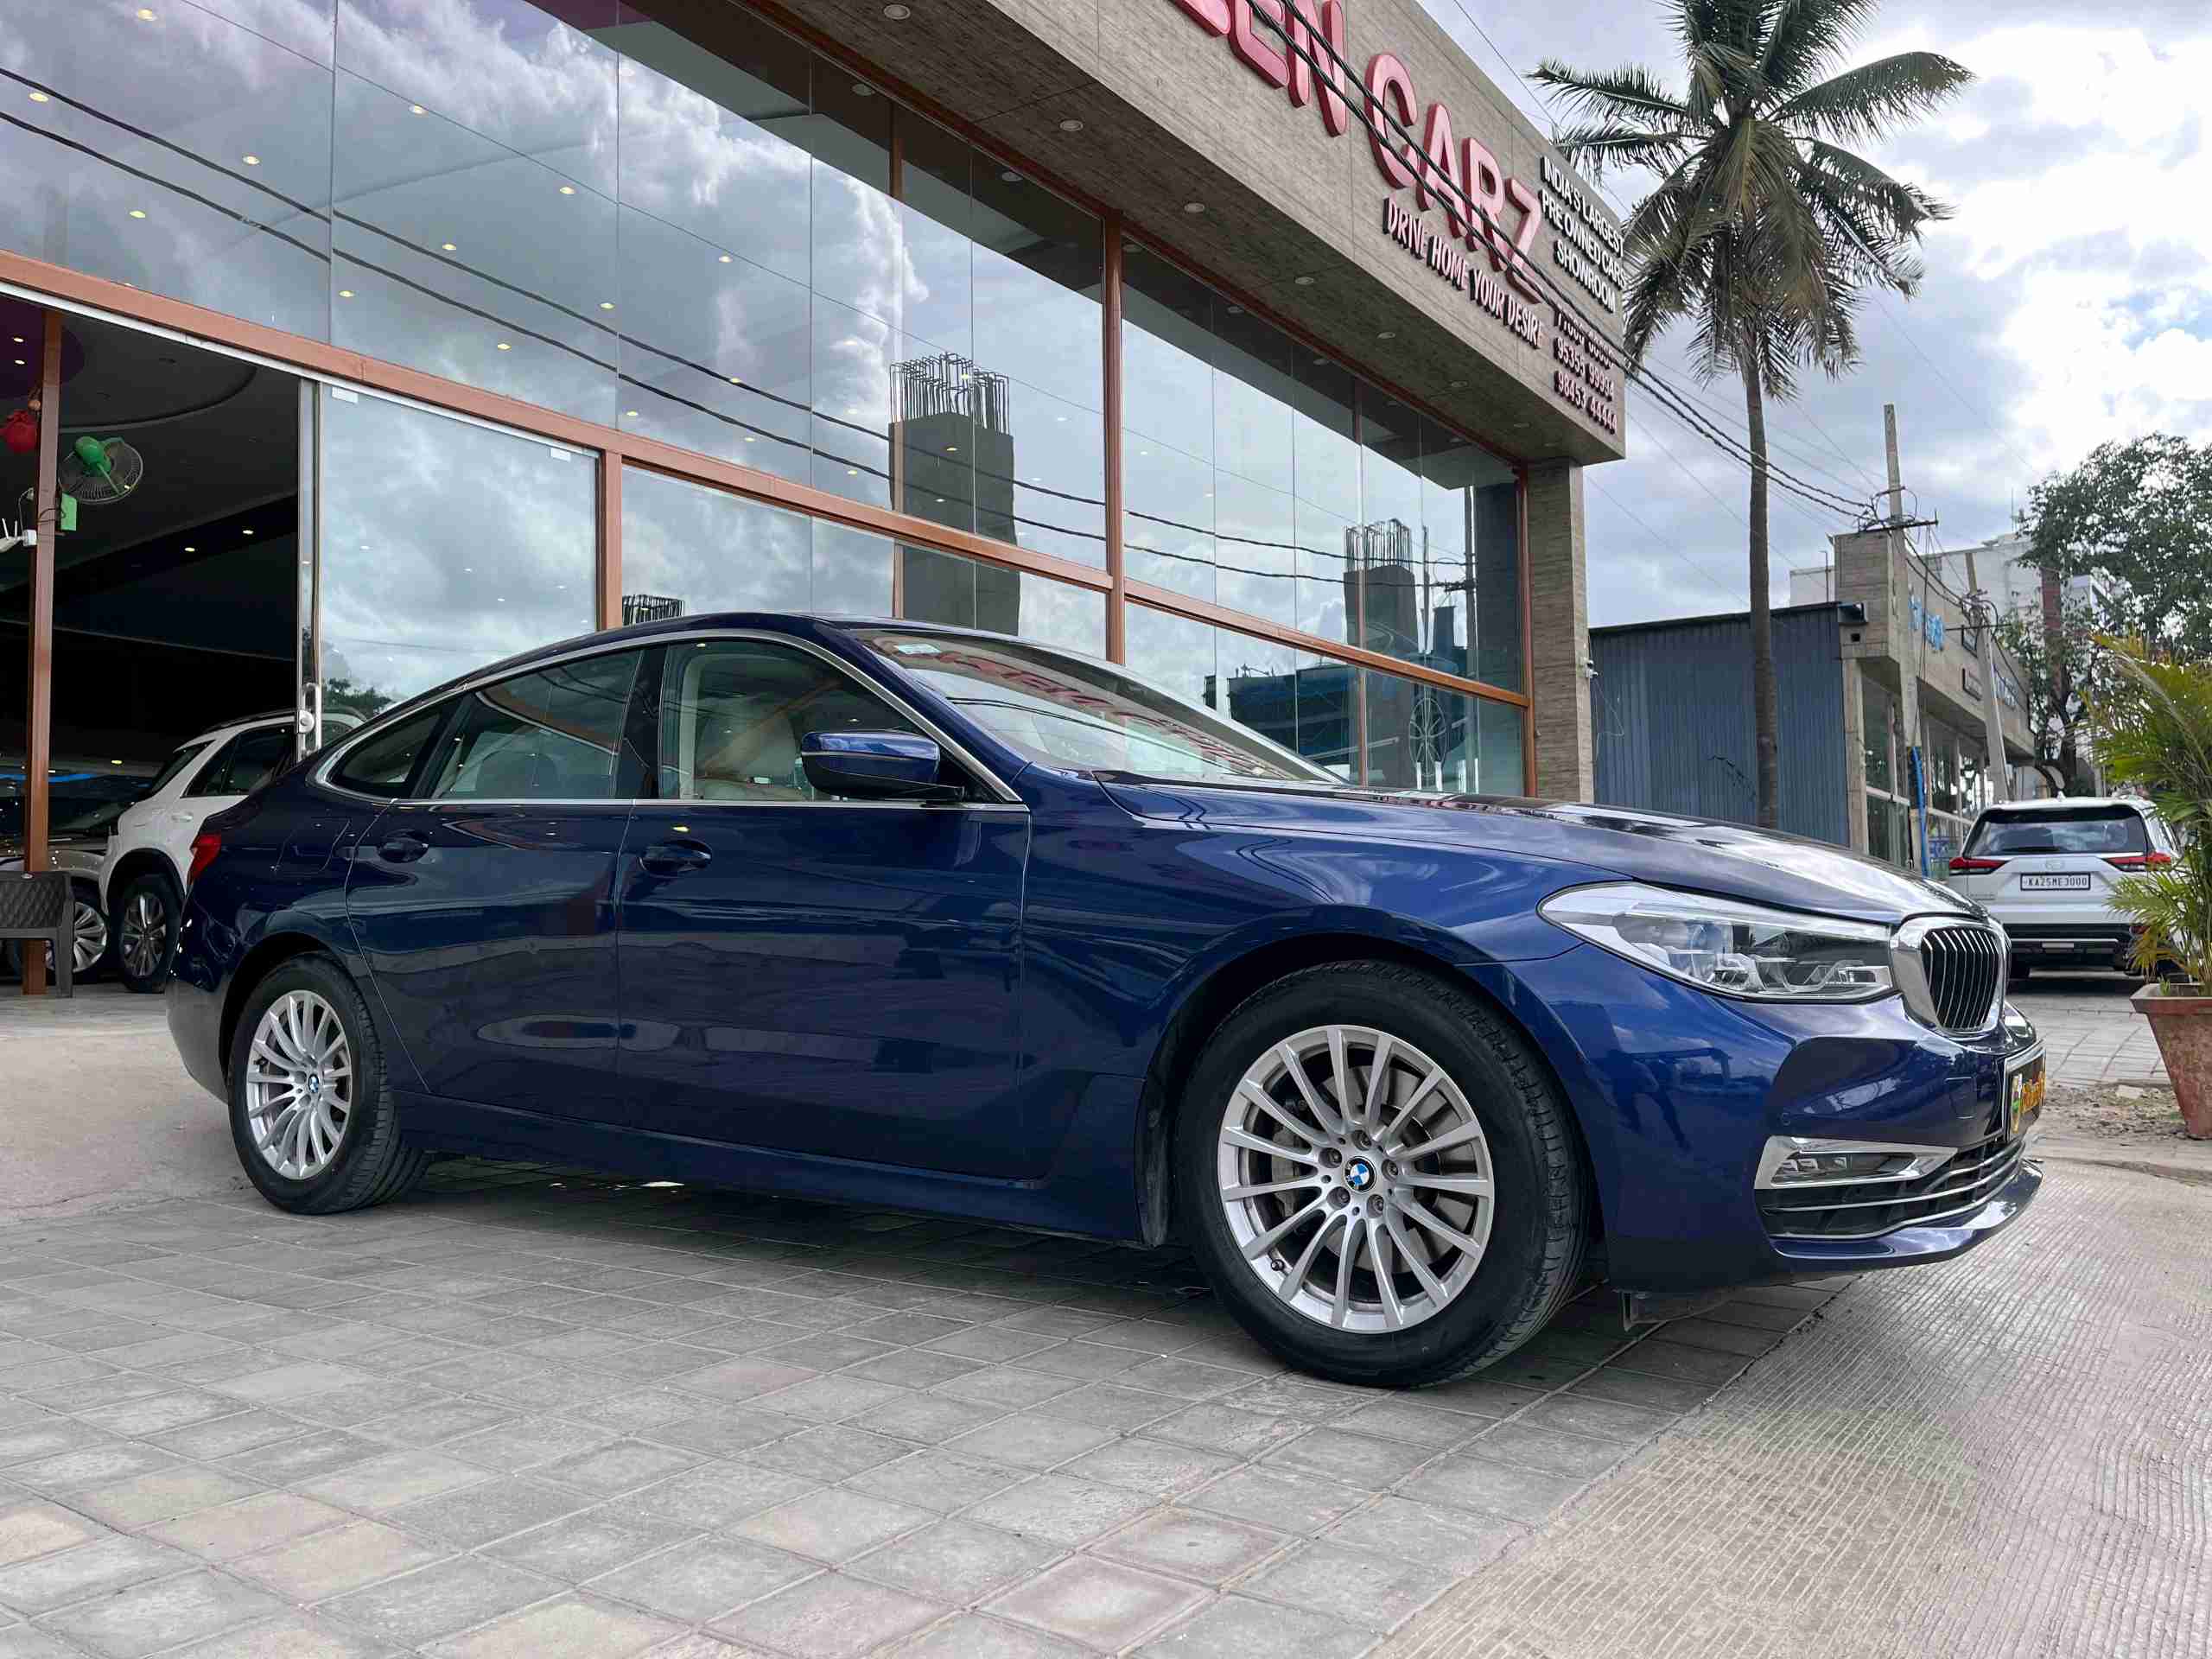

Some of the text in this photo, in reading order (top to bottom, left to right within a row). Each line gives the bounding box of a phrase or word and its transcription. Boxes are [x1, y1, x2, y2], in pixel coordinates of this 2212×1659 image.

[1364, 54, 1542, 303] CARZ
[1542, 156, 1581, 213] INDIA'S
[1582, 195, 1624, 258] LARGEST
[1428, 234, 1469, 290] HOME
[1471, 269, 1505, 319] YOUR
[1540, 188, 1626, 290] PRE OWNED CARS
[1555, 239, 1616, 313] SHOWROOM
[2027, 876, 2088, 887] KA25ME3000
